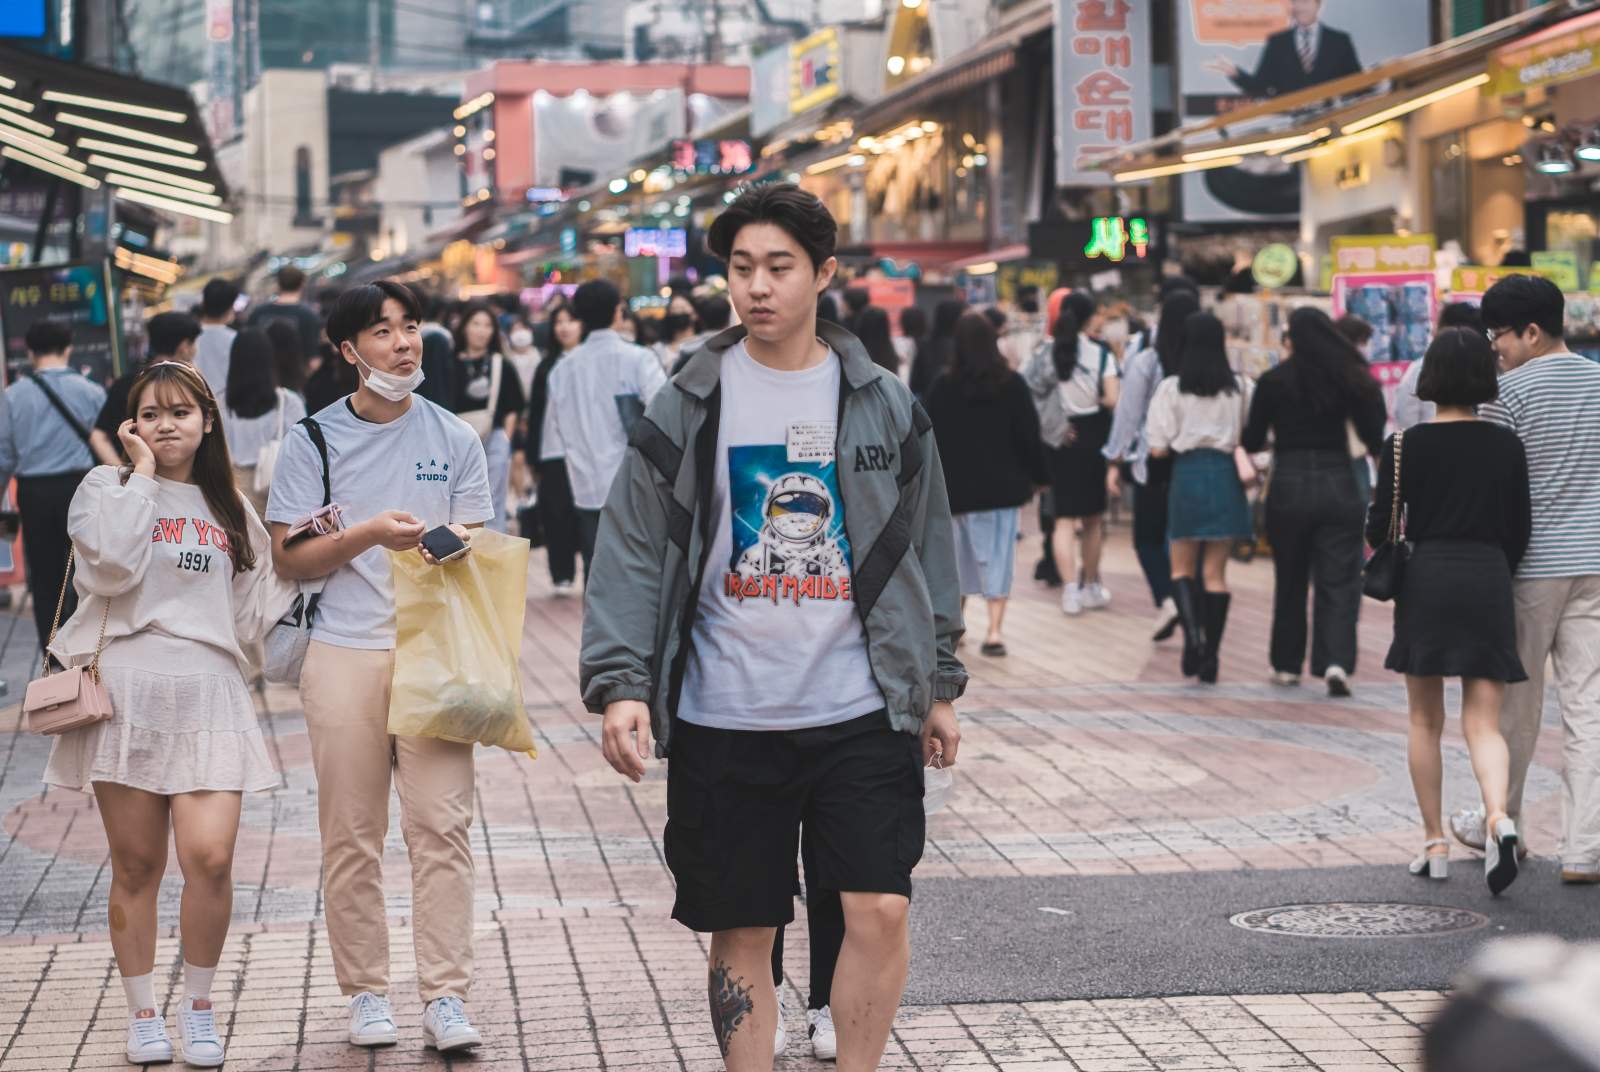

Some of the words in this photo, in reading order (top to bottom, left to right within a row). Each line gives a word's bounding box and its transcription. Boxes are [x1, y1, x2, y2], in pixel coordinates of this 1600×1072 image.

[415, 473, 448, 482] STUDIO
[151, 517, 187, 544] EW
[191, 517, 229, 552] YO
[176, 551, 212, 573] 199X
[723, 572, 778, 605] IRON
[780, 573, 851, 608] MAIDE
